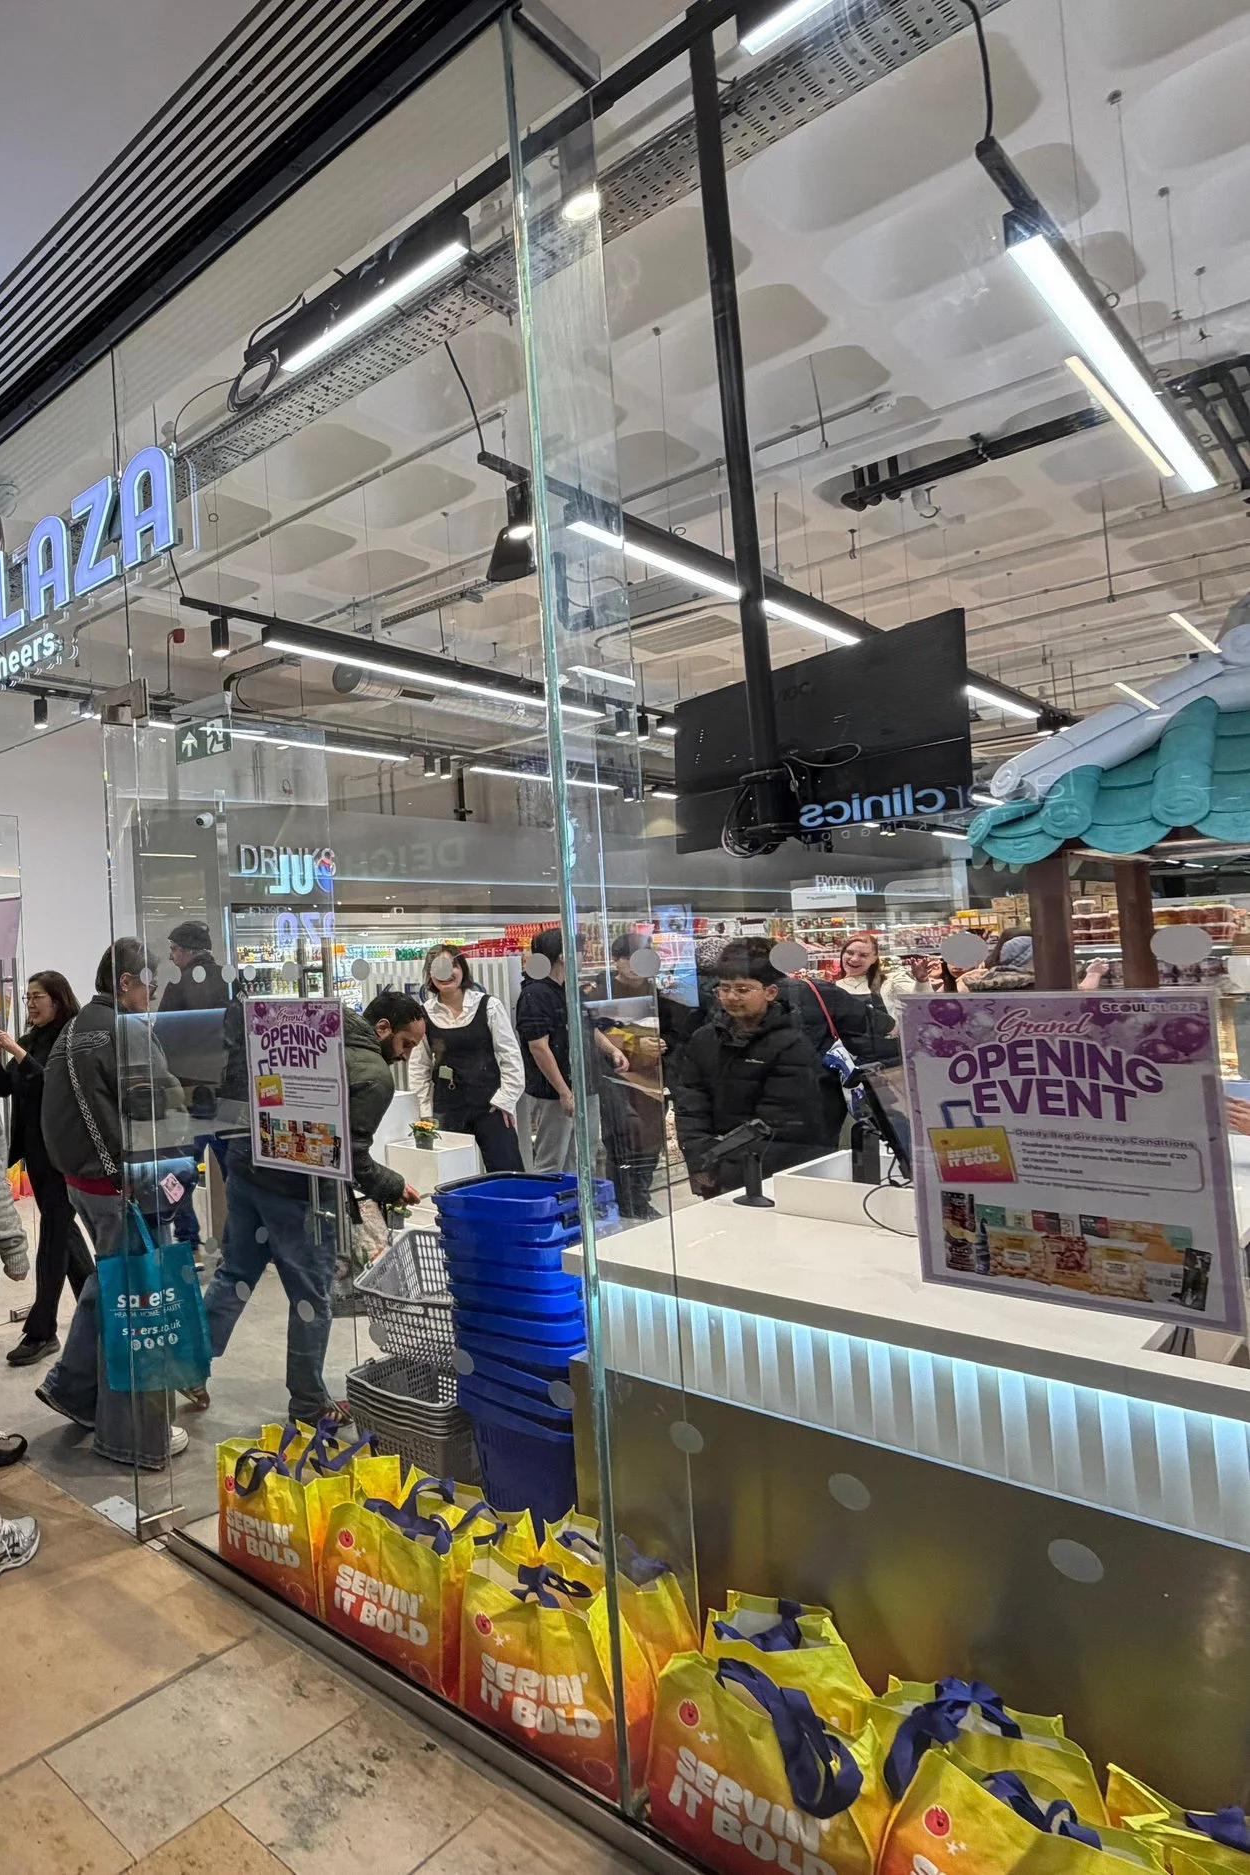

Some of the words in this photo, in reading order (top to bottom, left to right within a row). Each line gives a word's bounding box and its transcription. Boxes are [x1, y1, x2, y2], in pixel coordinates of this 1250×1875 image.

[997, 1009, 1092, 1043] Grand
[1102, 1003, 1149, 1013] SEOUL
[261, 1024, 327, 1053] OPENING
[269, 1046, 320, 1069] EVENT
[949, 1038, 1164, 1094] OPENING
[973, 1078, 1138, 1122] EVENT
[1130, 1137, 1195, 1149] Conditions
[226, 1506, 294, 1545] SERVIN'
[226, 1526, 242, 1549] IT
[246, 1534, 300, 1569] BOLD
[336, 1564, 424, 1619] SERVIN'
[334, 1587, 356, 1616] IT
[360, 1602, 429, 1646] BOLD
[480, 1677, 503, 1711] IT
[512, 1696, 601, 1739] BOLD
[669, 1774, 702, 1819] IT
